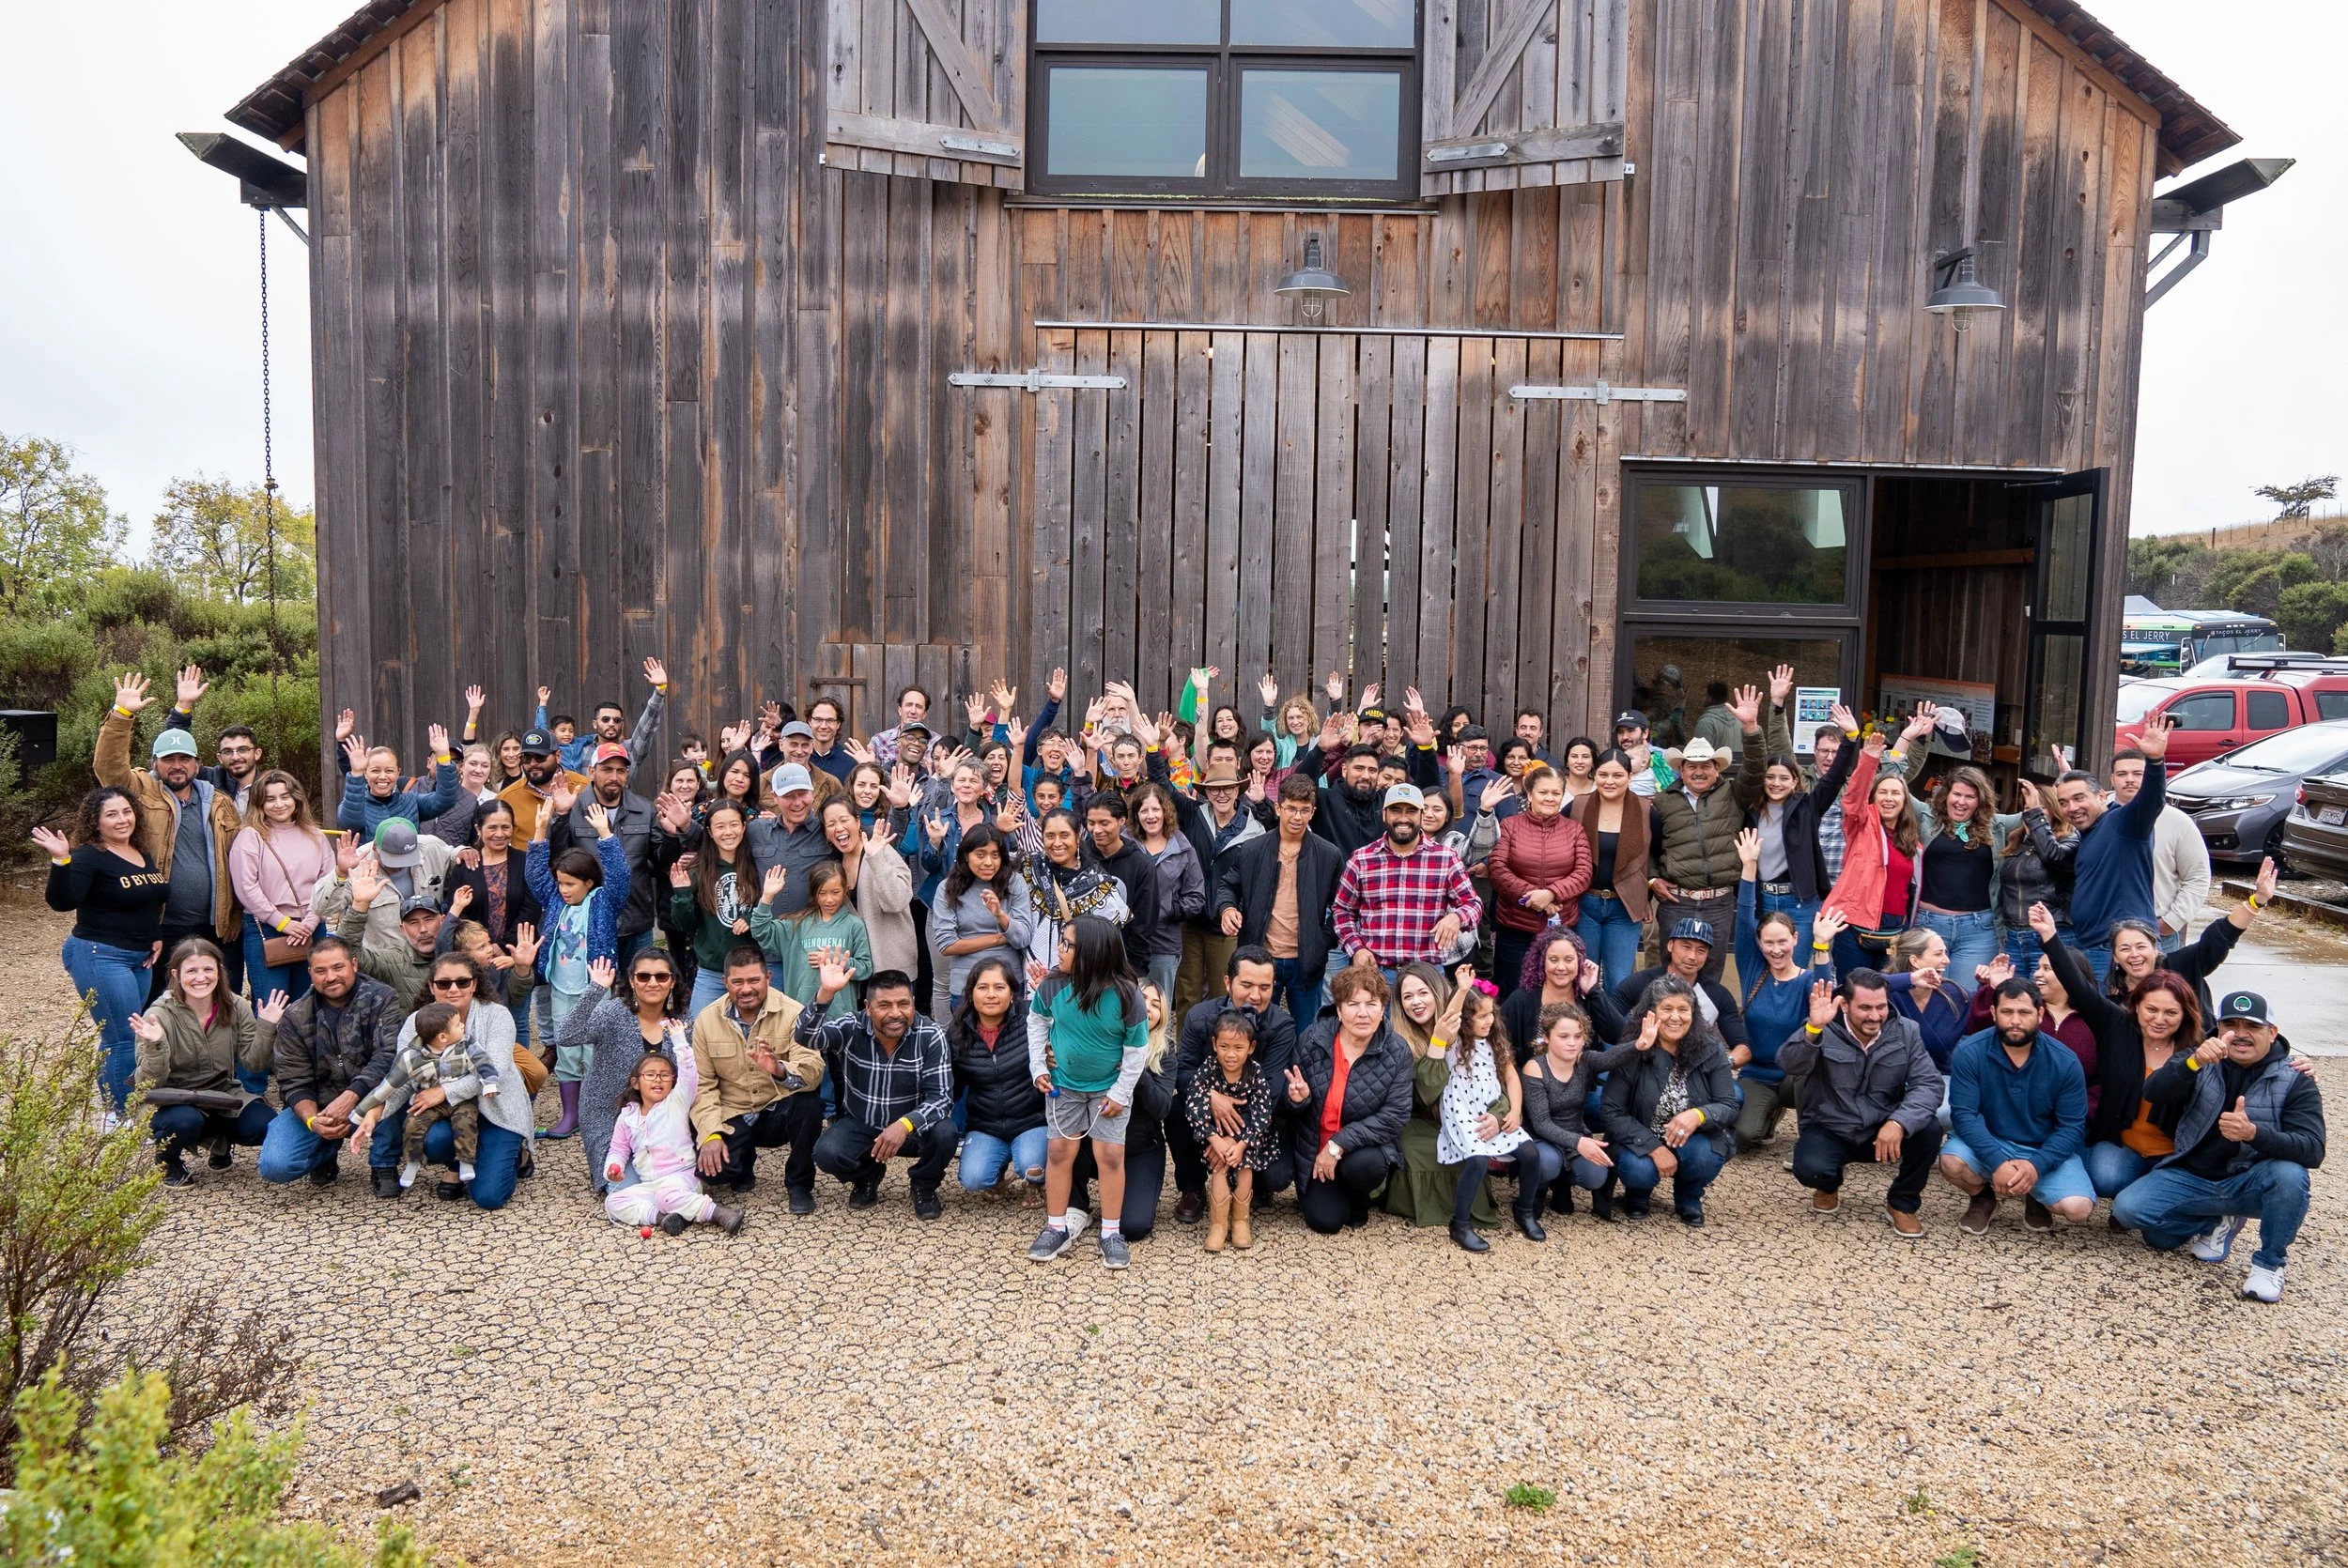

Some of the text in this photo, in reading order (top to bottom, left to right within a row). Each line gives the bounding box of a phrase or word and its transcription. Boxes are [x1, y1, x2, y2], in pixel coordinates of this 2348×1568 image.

[2130, 631, 2139, 640] EL
[2143, 631, 2170, 642] JERRY
[119, 876, 131, 888] G
[131, 873, 148, 886] BY
